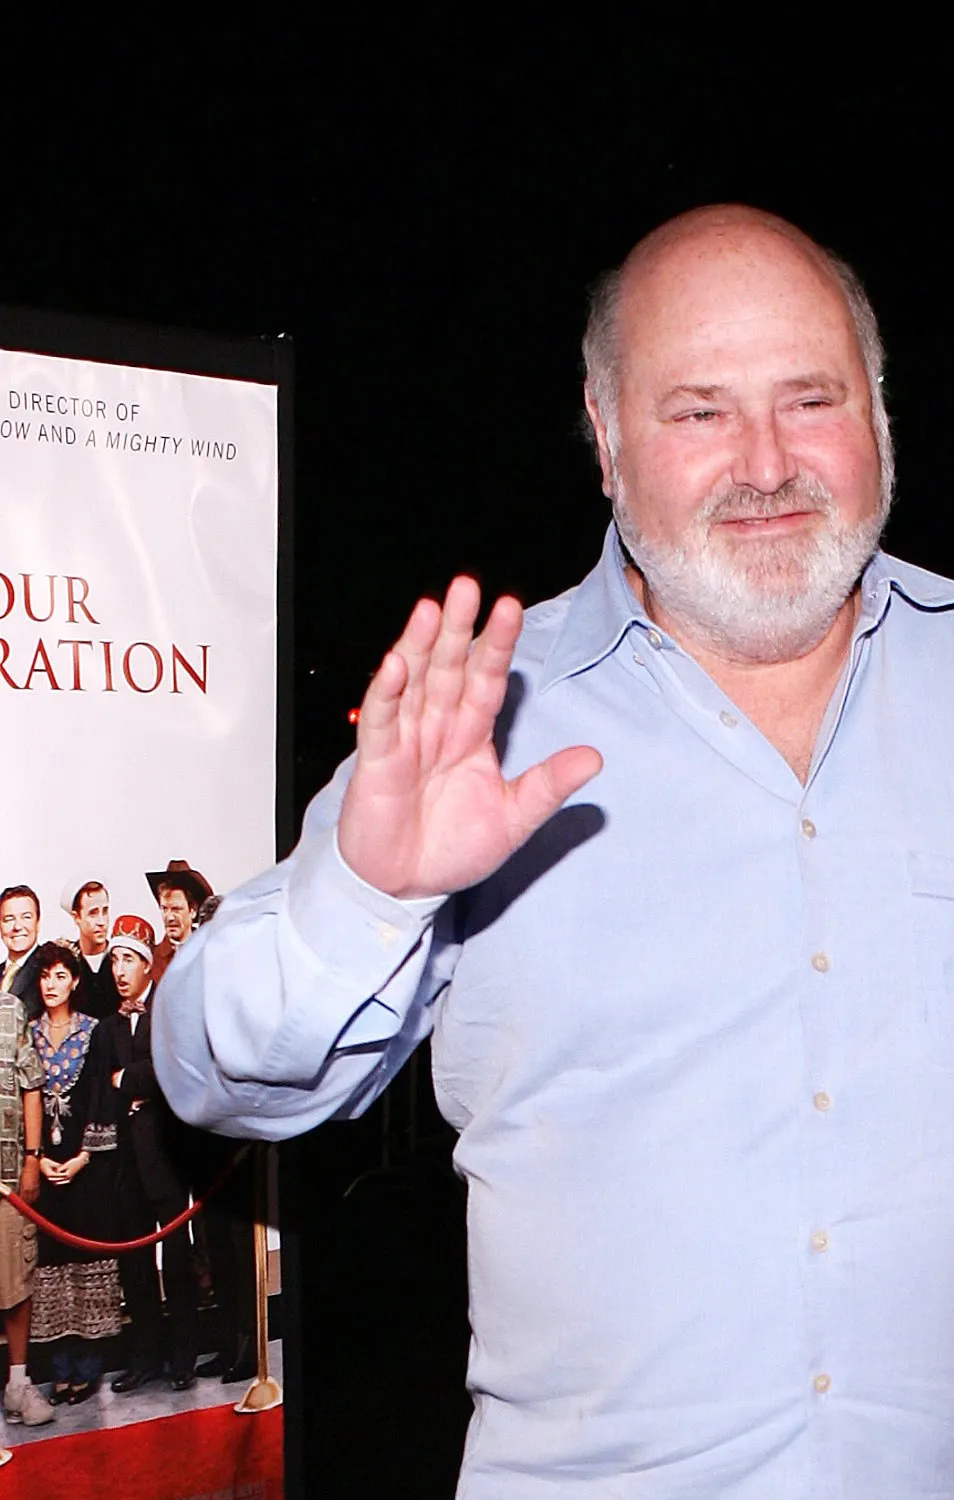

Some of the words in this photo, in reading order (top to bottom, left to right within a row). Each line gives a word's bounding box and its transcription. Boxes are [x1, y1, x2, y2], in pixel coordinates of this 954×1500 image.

[9, 390, 107, 419] DIRECTOR
[116, 403, 140, 422] OF
[0, 420, 31, 440] OW
[38, 424, 76, 445] AND
[85, 430, 97, 448] A
[106, 432, 182, 455] MIGHTY
[190, 439, 237, 461] WIND
